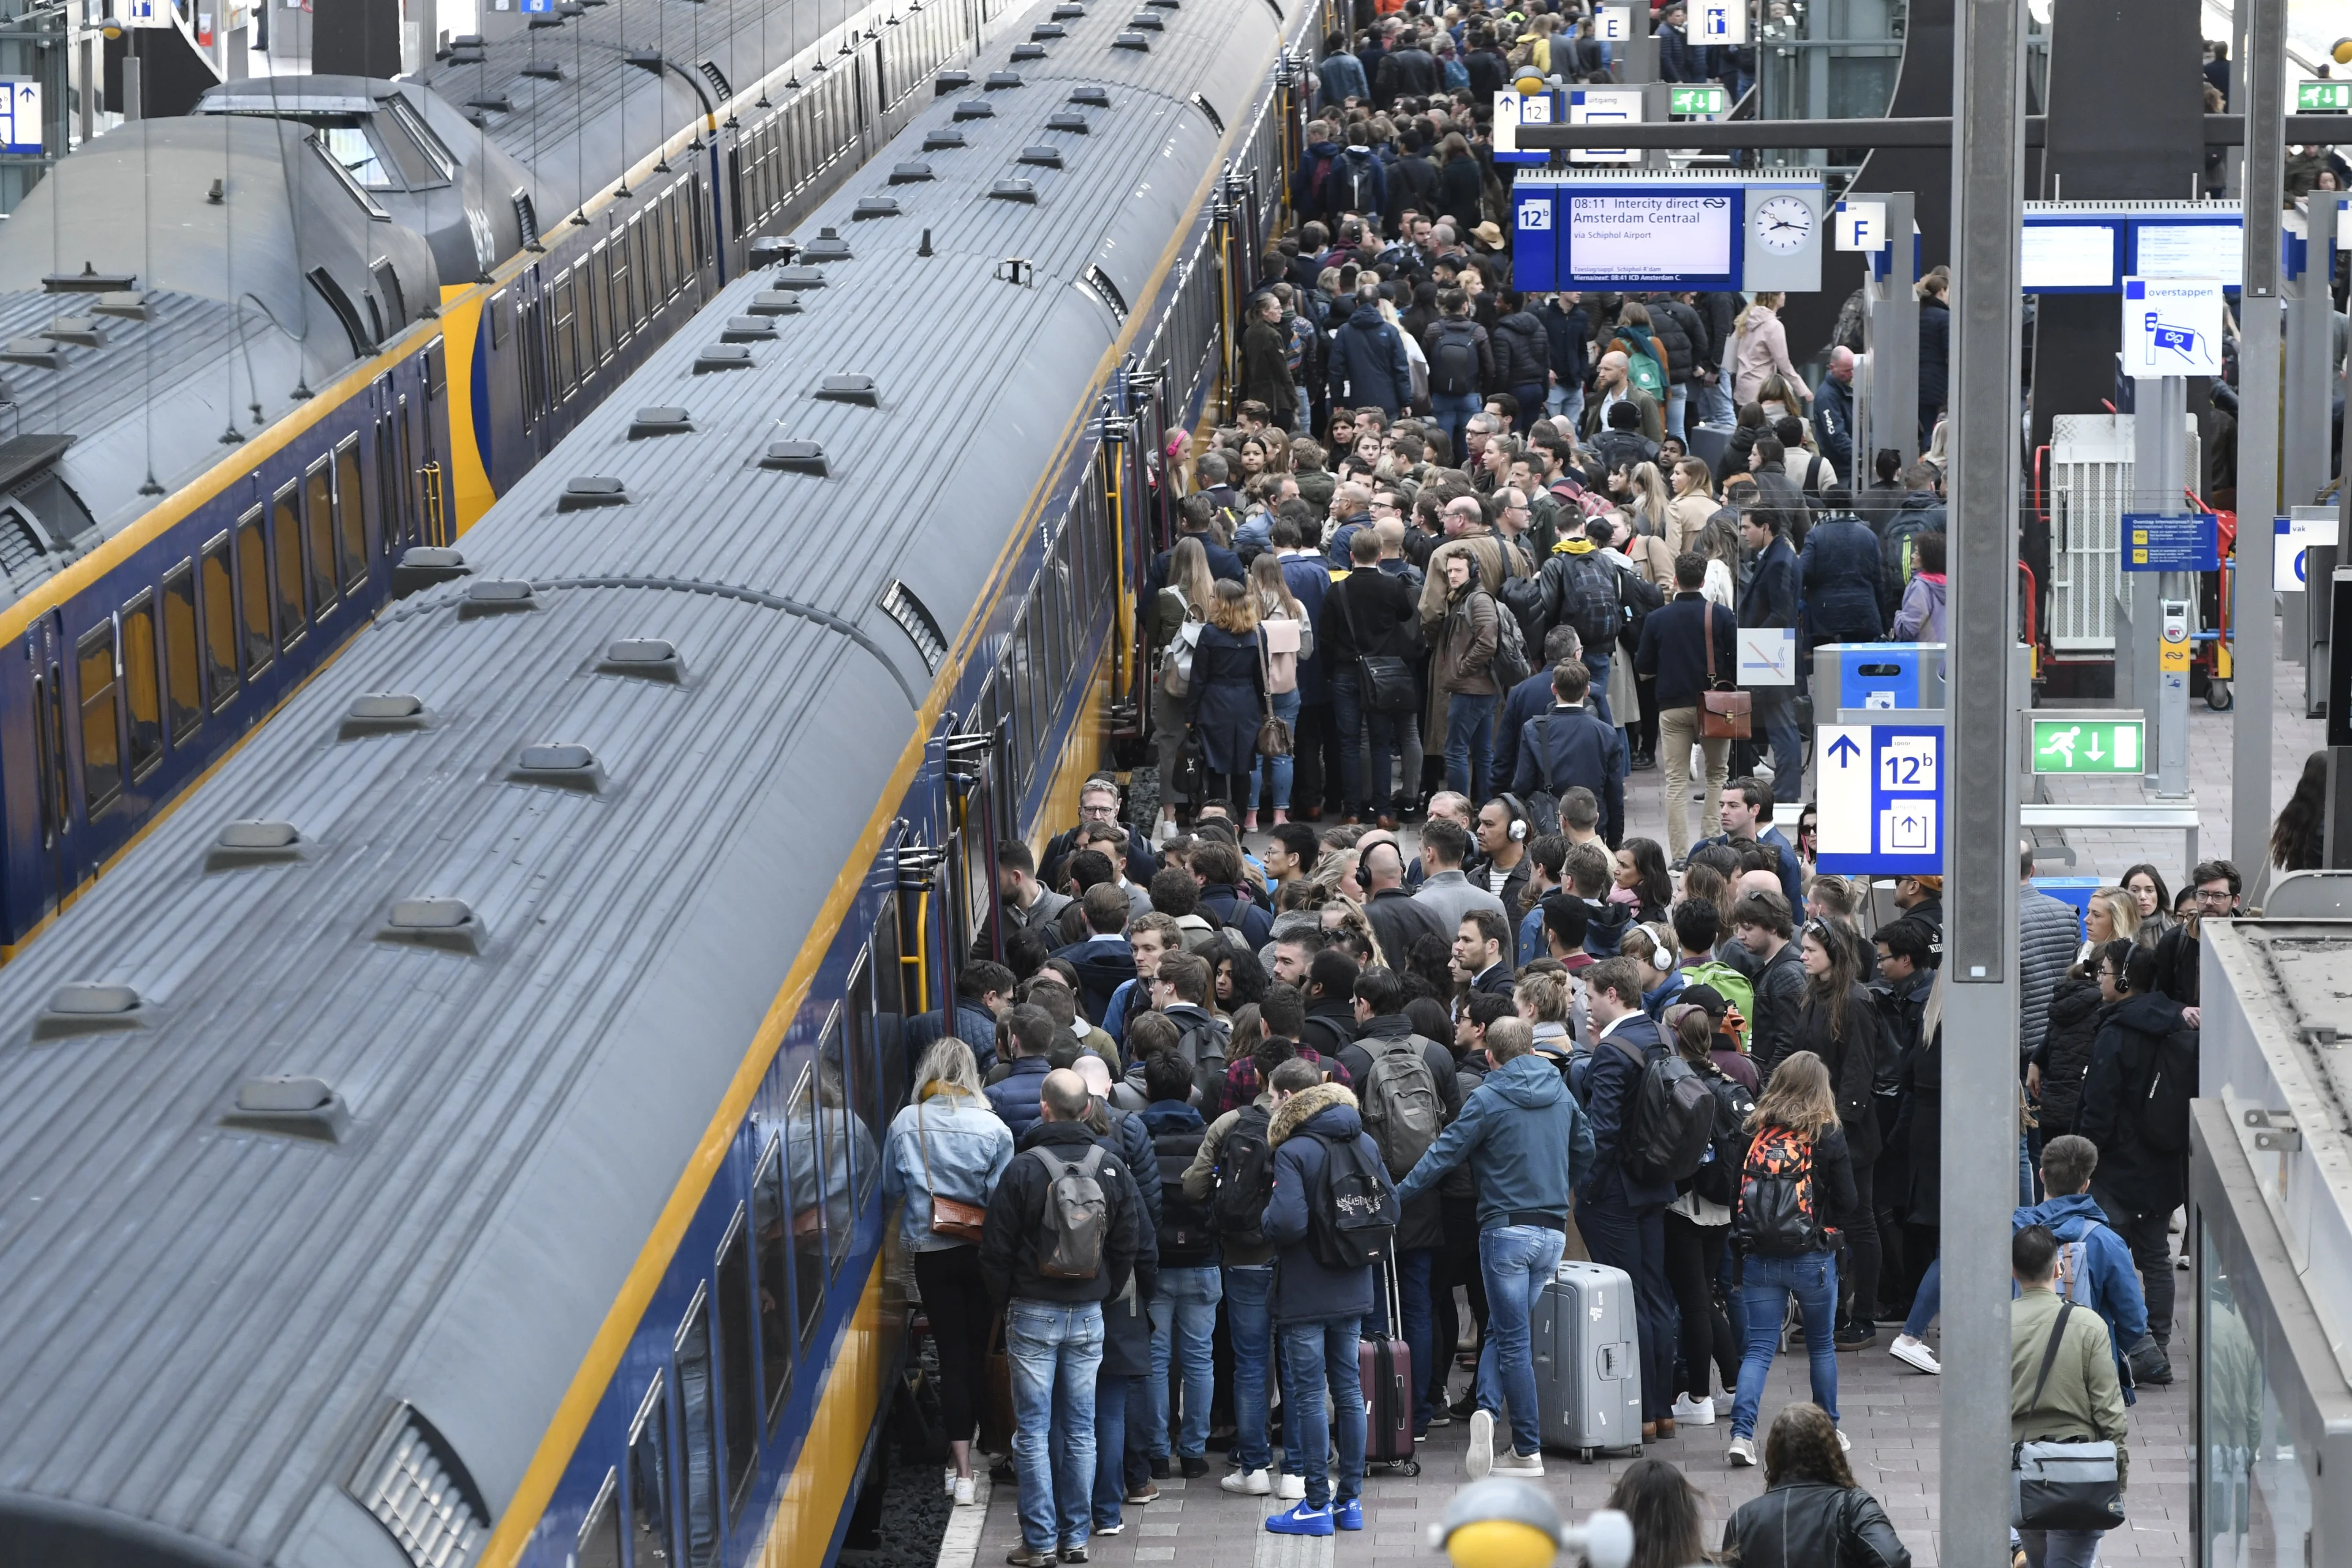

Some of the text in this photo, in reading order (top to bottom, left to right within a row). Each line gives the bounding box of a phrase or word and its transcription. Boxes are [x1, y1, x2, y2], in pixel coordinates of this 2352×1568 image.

[1607, 20, 1618, 37] E
[1574, 198, 1699, 210] 08:11 Intercity direct
[1574, 213, 1700, 223] Amsterdam Centraal
[1588, 232, 1621, 241] Schiphol
[1623, 232, 1651, 241] Airport
[1854, 221, 1868, 246] F
[2149, 289, 2213, 298] overstappen
